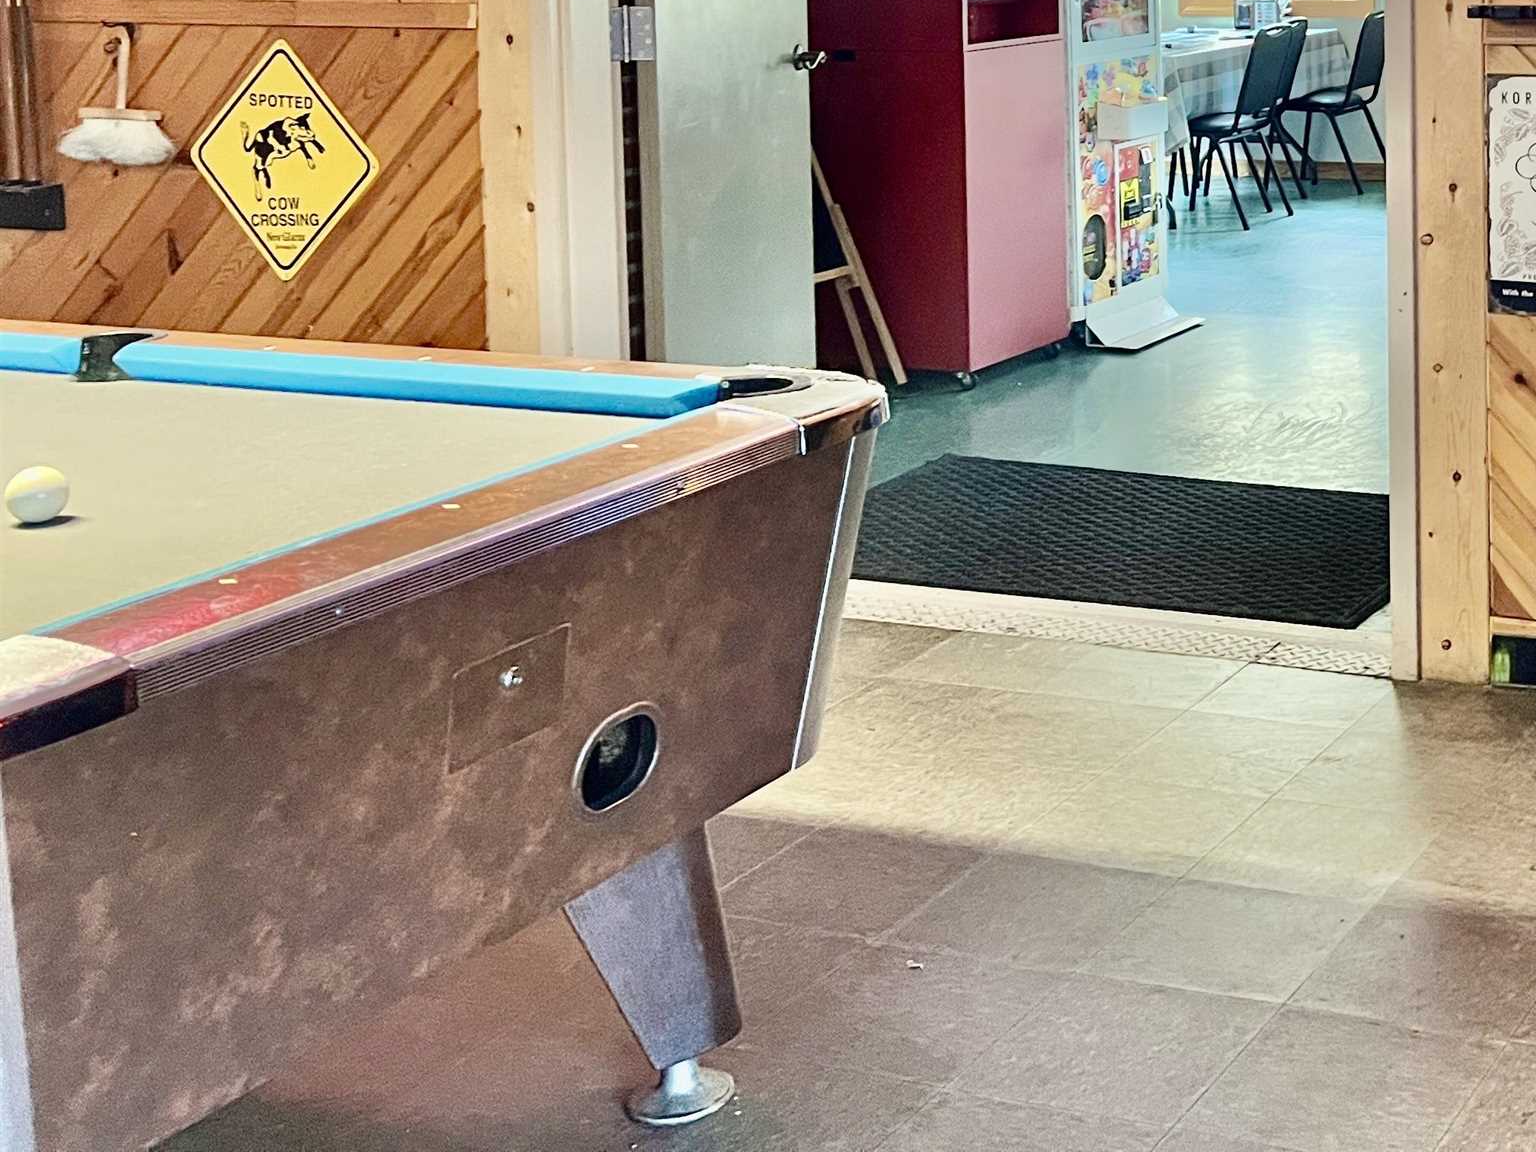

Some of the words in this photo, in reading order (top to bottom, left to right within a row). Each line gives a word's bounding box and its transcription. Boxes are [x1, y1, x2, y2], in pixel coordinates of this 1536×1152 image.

[249, 92, 313, 110] SPOTTED
[268, 197, 300, 211] COW
[251, 213, 320, 227] CROSSING
